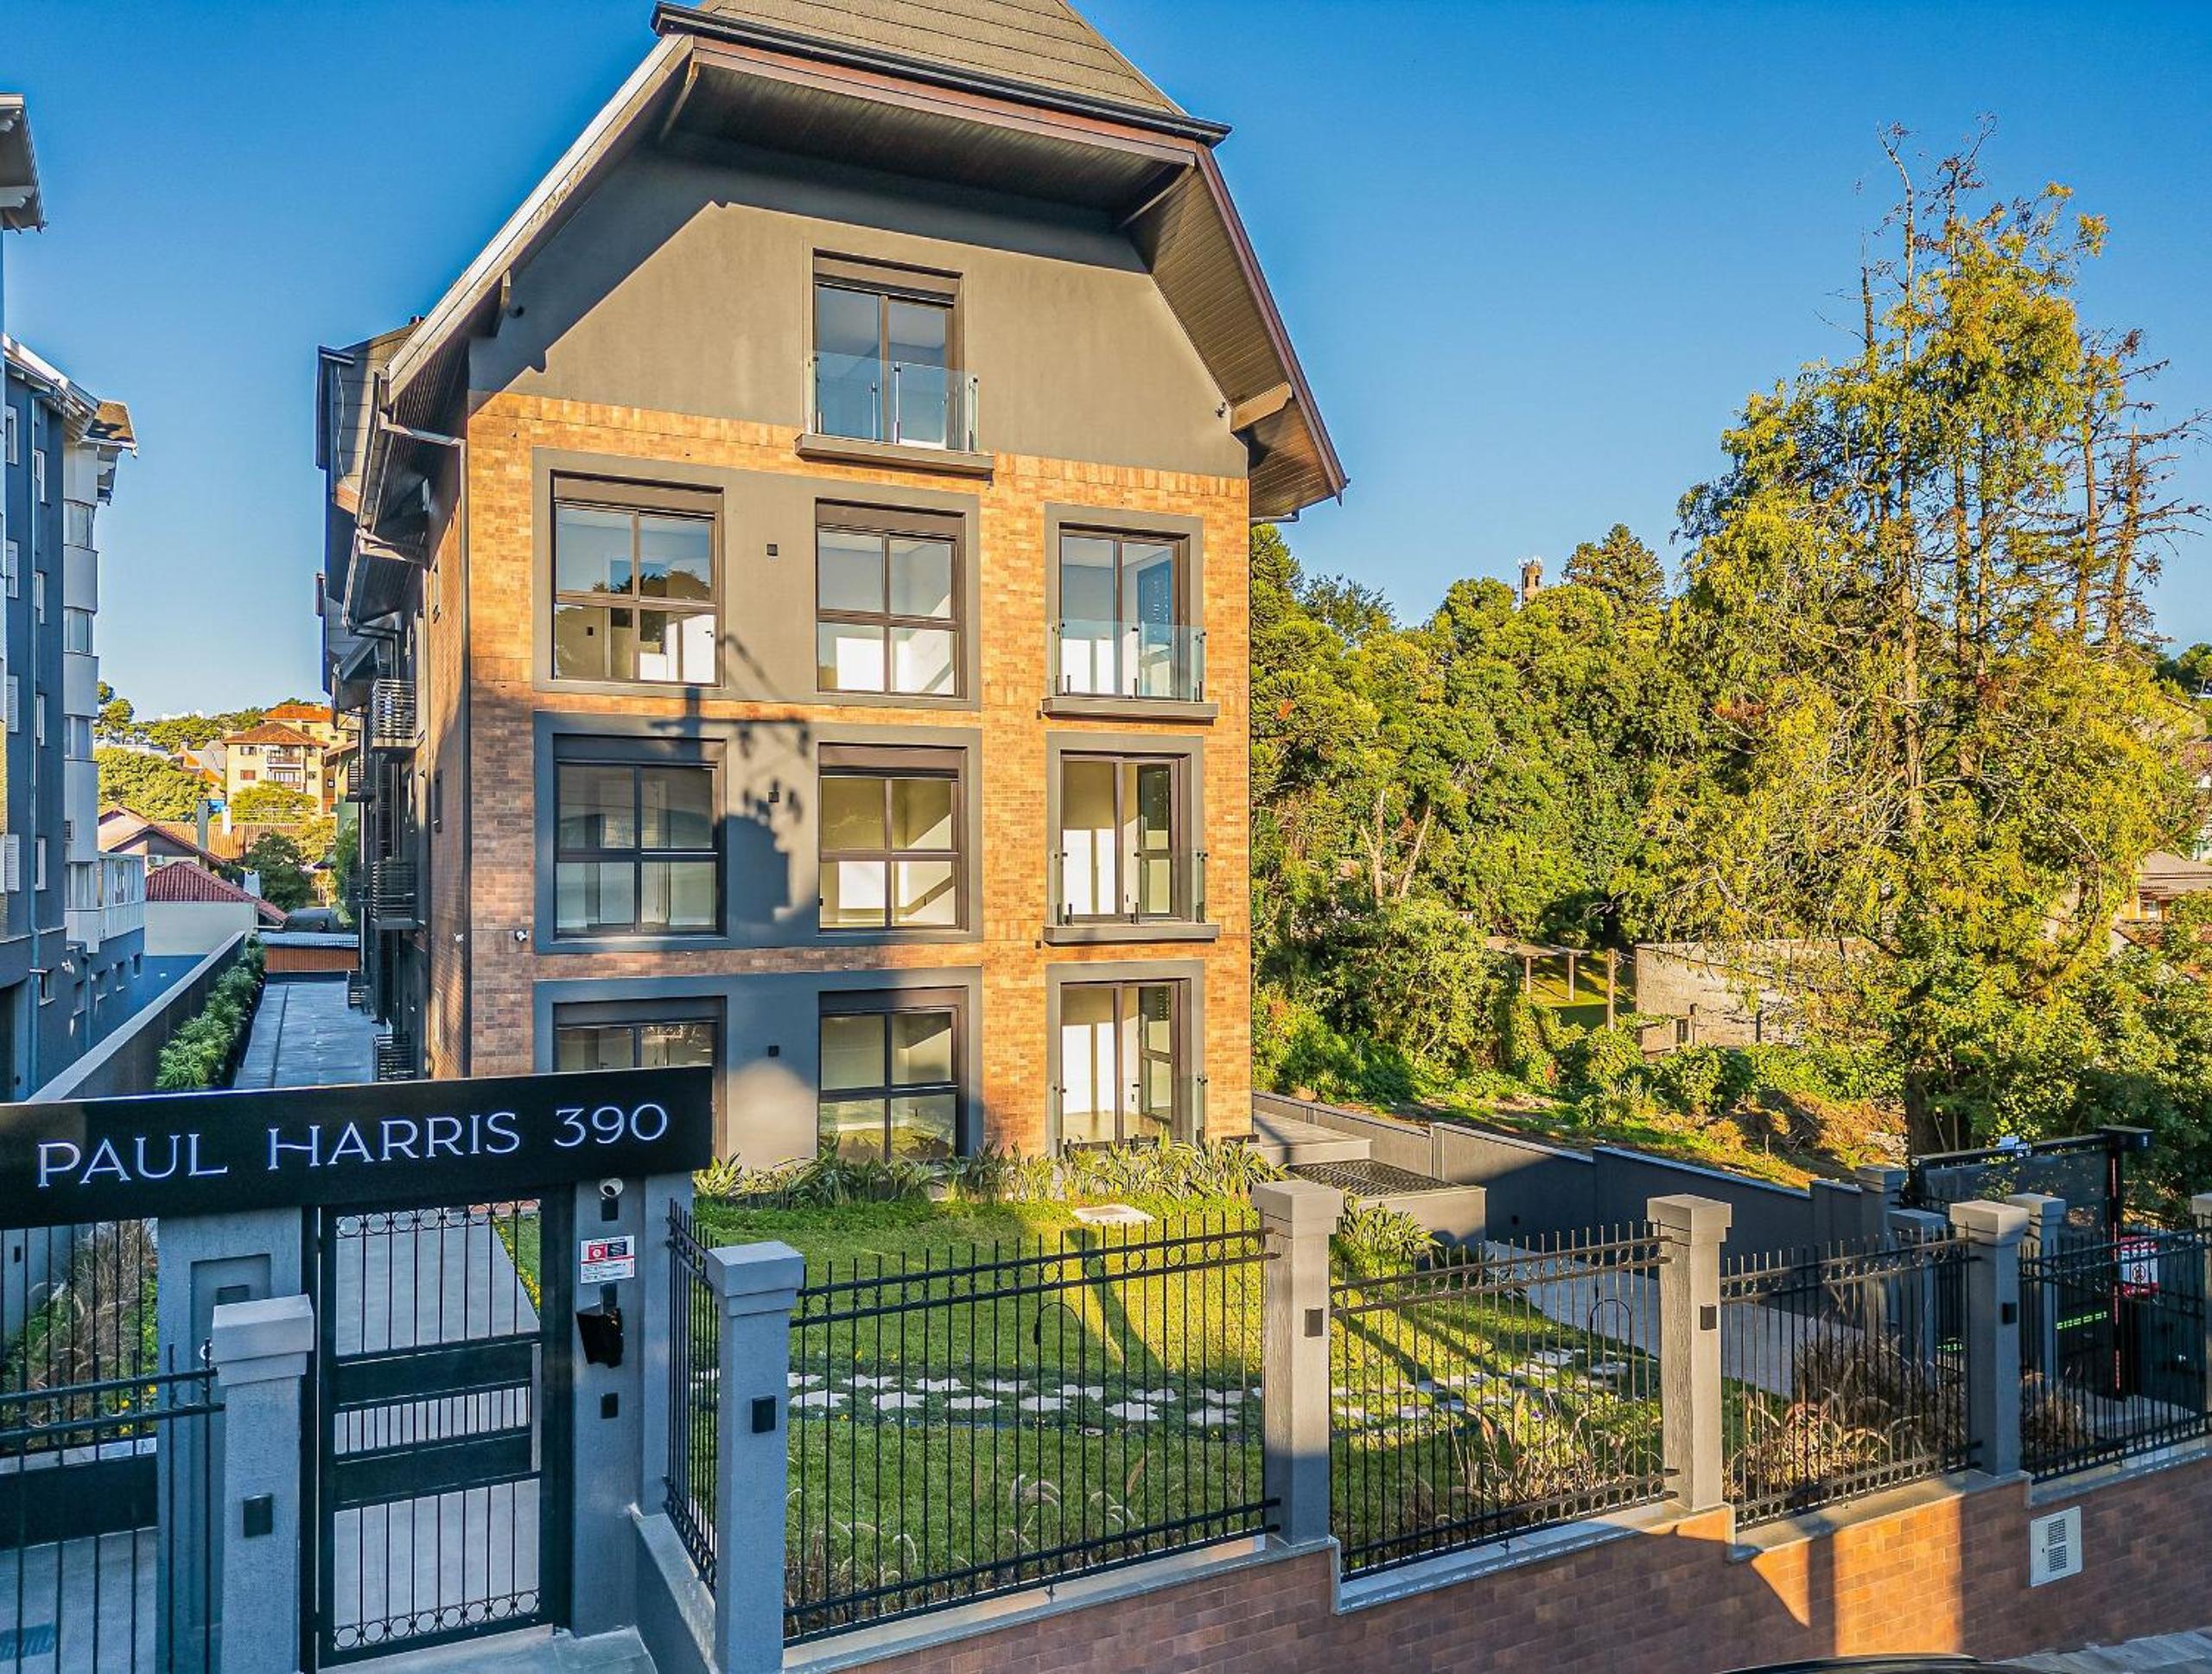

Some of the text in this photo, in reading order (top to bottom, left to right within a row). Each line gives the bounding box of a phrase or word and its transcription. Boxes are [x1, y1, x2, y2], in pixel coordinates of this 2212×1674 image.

[37, 1104, 668, 1187] PAUL HARRIS 390
